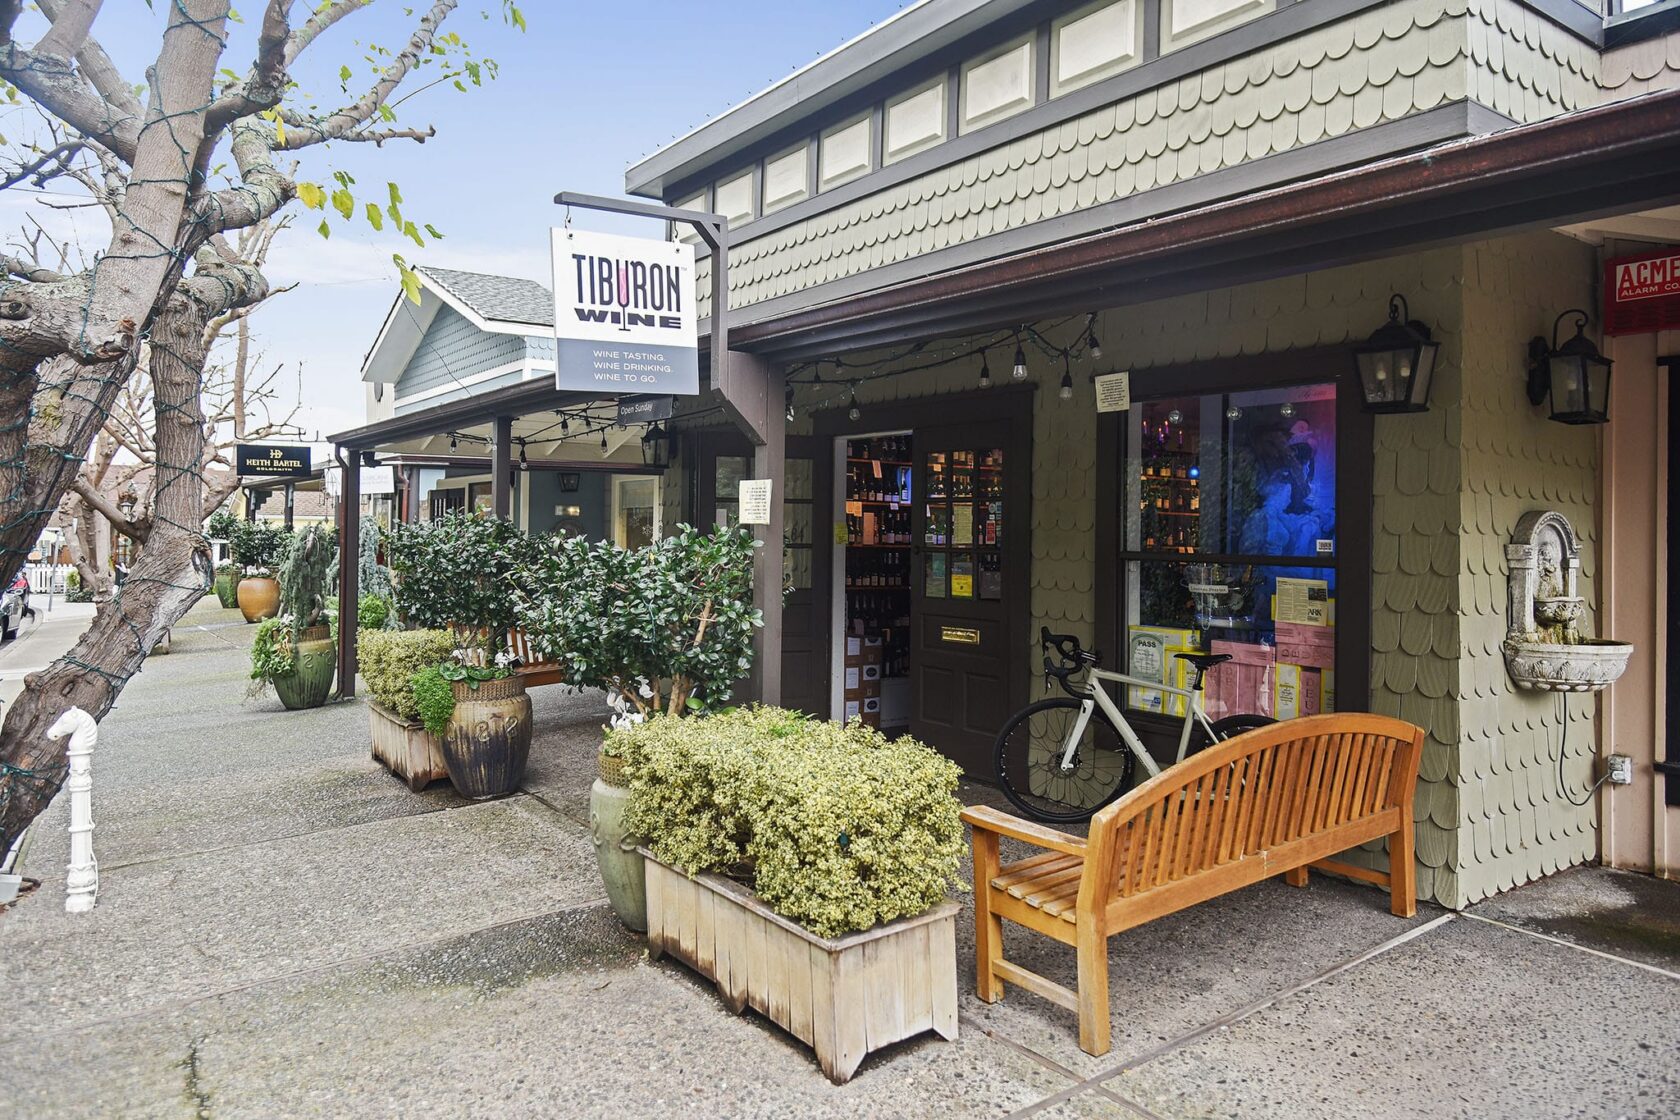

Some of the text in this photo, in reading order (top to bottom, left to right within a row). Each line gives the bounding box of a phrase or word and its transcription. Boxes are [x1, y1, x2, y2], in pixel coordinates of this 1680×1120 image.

[1619, 257, 1680, 288] ACME
[572, 254, 681, 312] TIBURON
[1621, 285, 1658, 297] ALARM
[574, 308, 681, 329] WINE
[593, 350, 666, 361] WINE TASTING.
[593, 362, 673, 373] WINE DRINKING.
[594, 373, 657, 383] WINE TO GO.
[620, 401, 654, 415] Open Sunday
[273, 459, 302, 467] BARTEL
[1137, 640, 1156, 648] PASS
[1304, 677, 1315, 715] DEU
